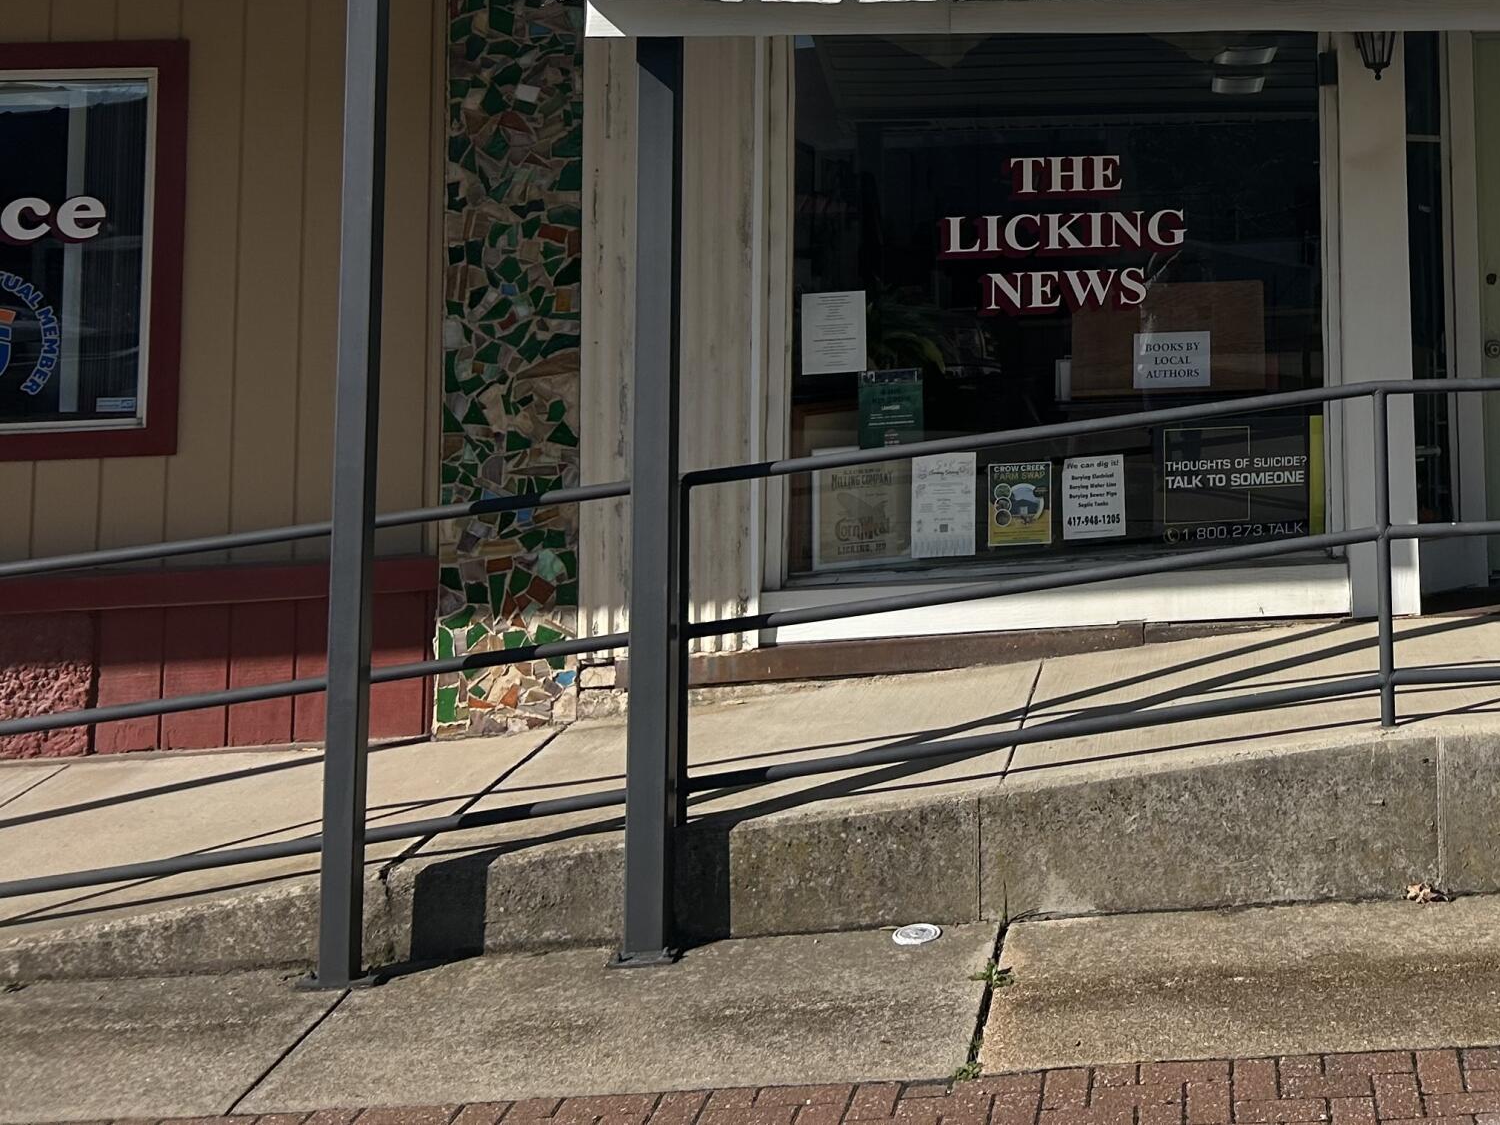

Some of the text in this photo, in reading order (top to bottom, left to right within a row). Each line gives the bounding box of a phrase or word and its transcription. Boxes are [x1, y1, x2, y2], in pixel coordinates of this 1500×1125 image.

[1010, 154, 1123, 194] THE
[945, 209, 1188, 254] LICKING
[986, 267, 1147, 310] NEWS
[0, 271, 60, 395] UAL MEMBER
[1145, 342, 1201, 352] BOOKS BY
[1154, 355, 1192, 365] LOCAL
[1146, 369, 1200, 379] AUTHORS
[993, 464, 1046, 473] CROW CREEK
[1067, 462, 1078, 470] We
[1096, 460, 1109, 469] dig
[1110, 459, 1119, 467] it!
[1166, 456, 1308, 472] THOUGHTS OF SUICIDE?
[1166, 471, 1305, 489] TALK TO SOMEONE
[1067, 513, 1121, 527] 417-948-1205
